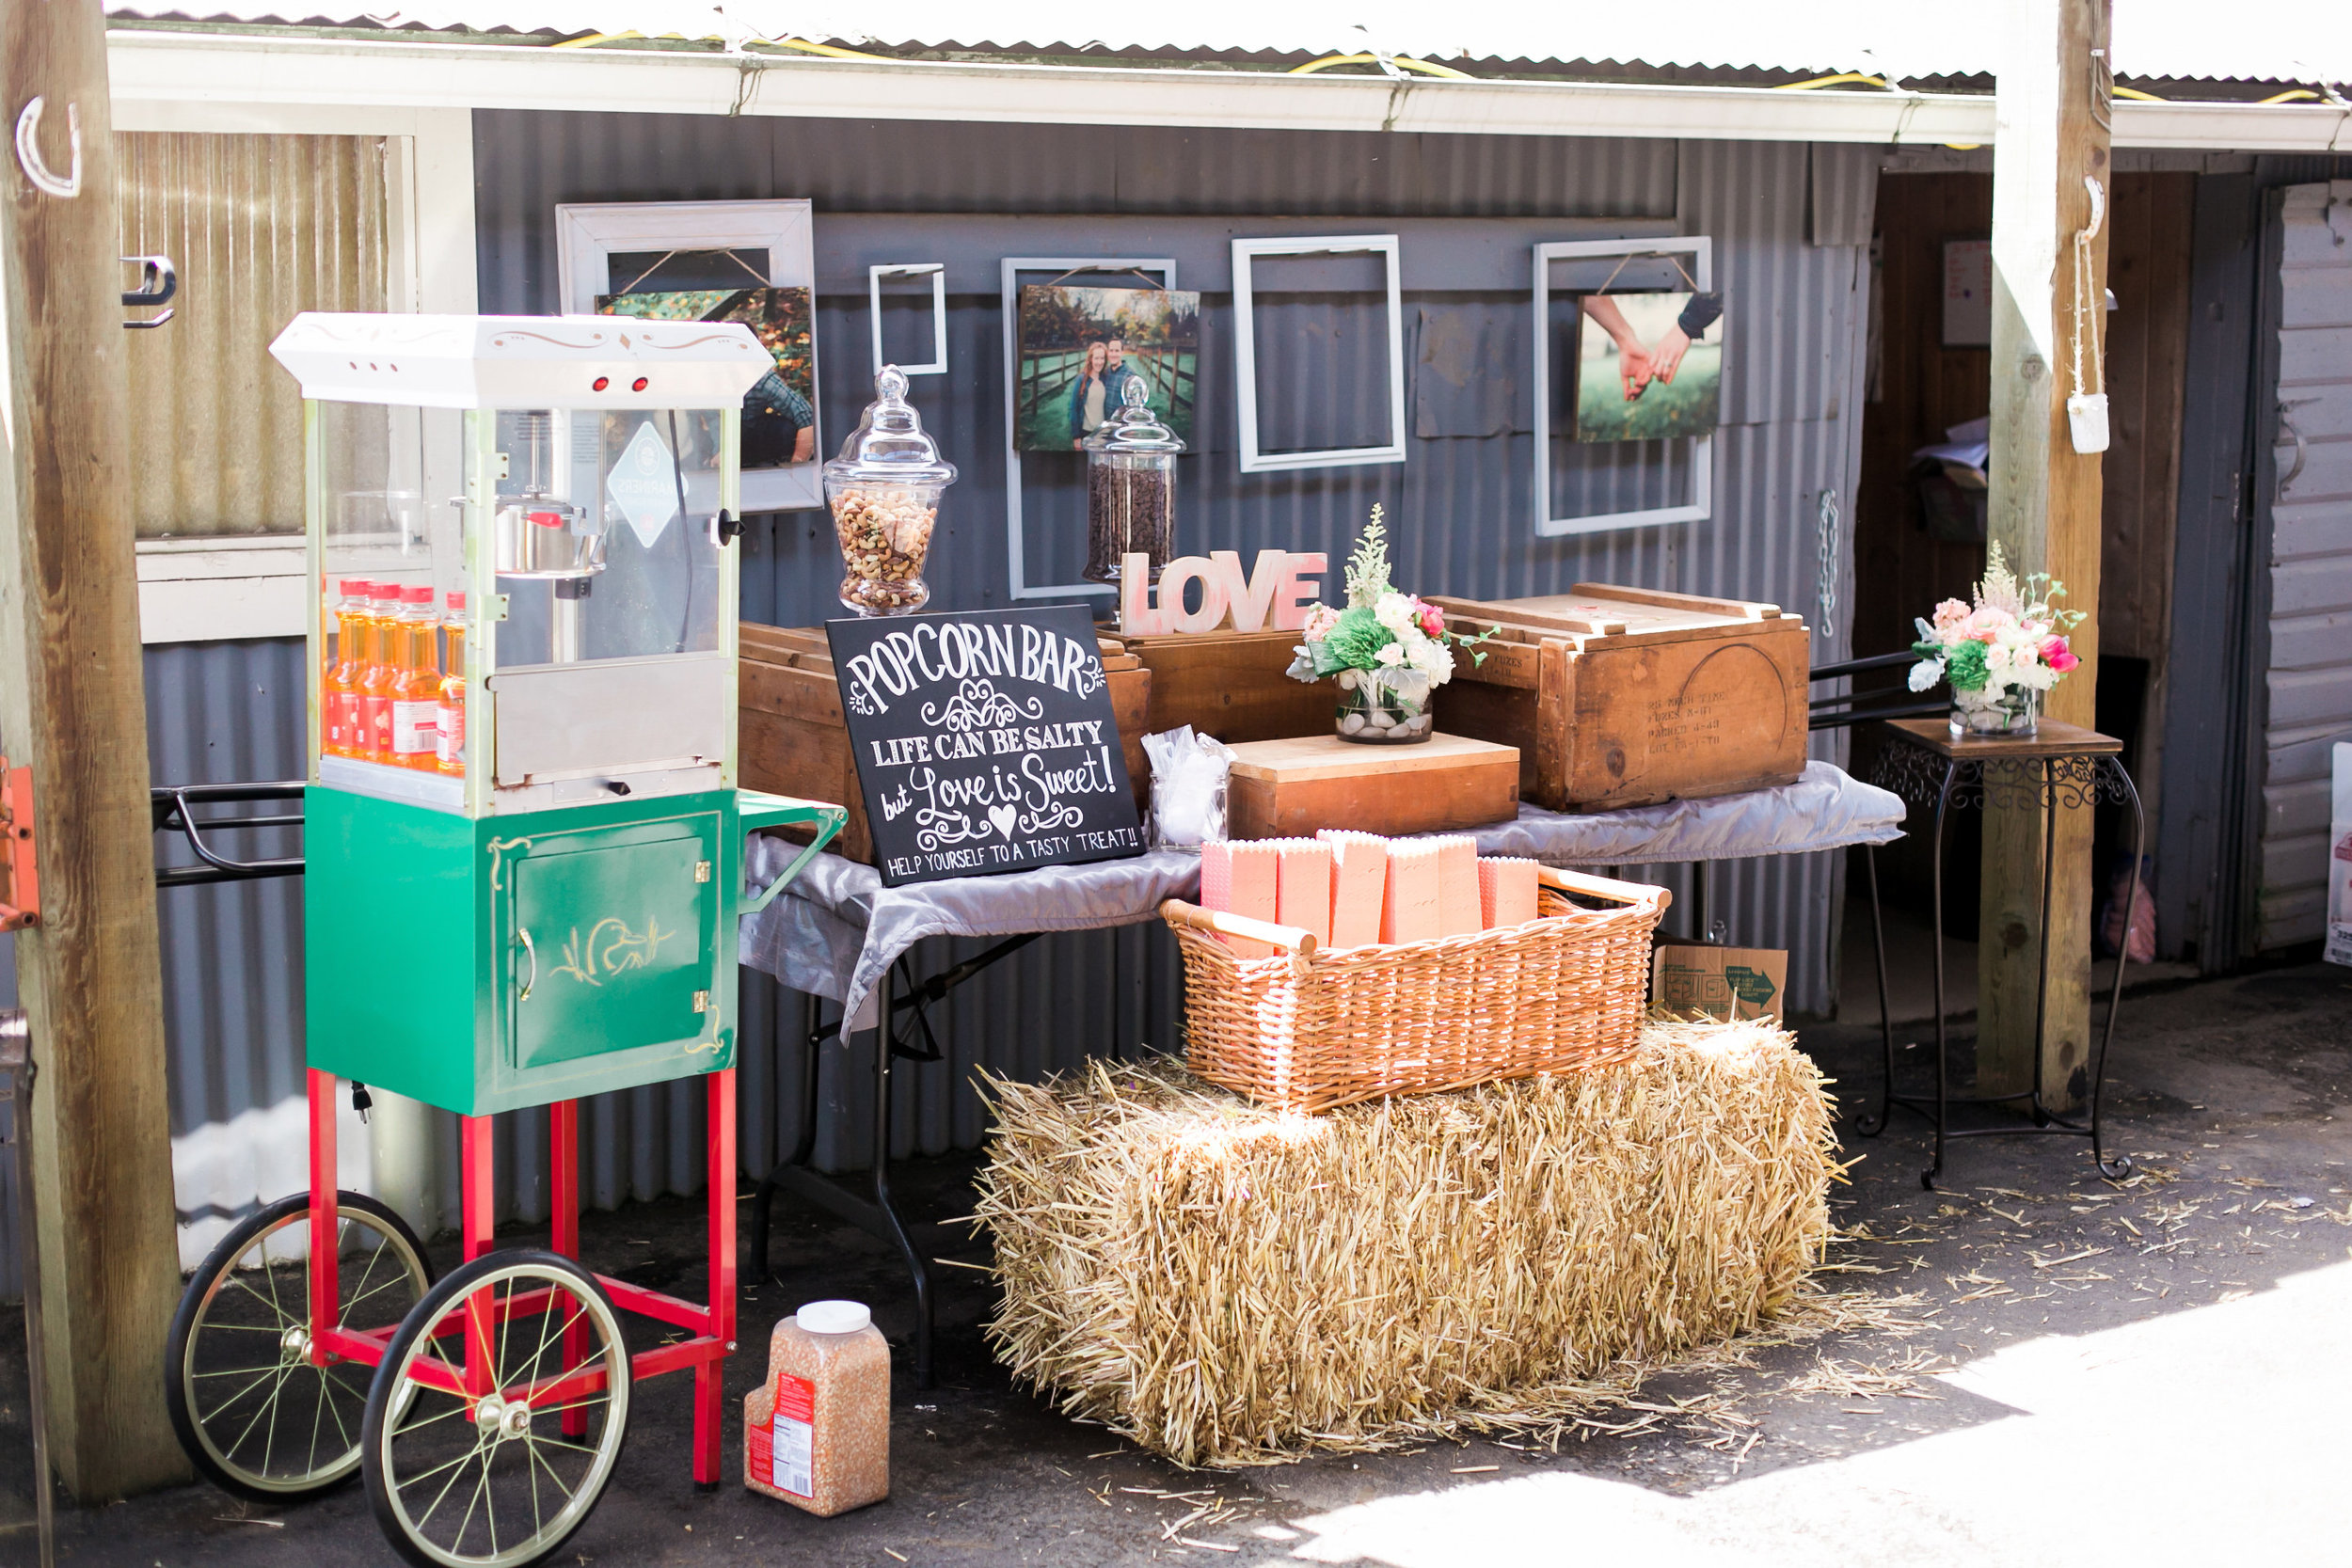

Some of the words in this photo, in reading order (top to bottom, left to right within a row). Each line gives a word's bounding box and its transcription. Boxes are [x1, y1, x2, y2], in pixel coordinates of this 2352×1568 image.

[1120, 549, 1327, 637] LOVE
[846, 623, 1016, 714] POPCORN
[1020, 624, 1088, 700] BAR
[870, 736, 932, 767] LIFE
[934, 731, 987, 760] CAN
[989, 728, 1024, 755] BE
[1025, 721, 1103, 750] SALTY
[881, 784, 913, 821] but
[909, 767, 993, 825] Love
[992, 765, 1023, 802] is
[1021, 745, 1117, 813] Sweet!
[888, 855, 922, 878] HELP
[925, 847, 985, 872] YOURSELF
[990, 844, 1009, 863] TO
[1012, 842, 1025, 861] A
[1026, 835, 1071, 858] TASTY
[1075, 828, 1138, 852] TREAT!!
